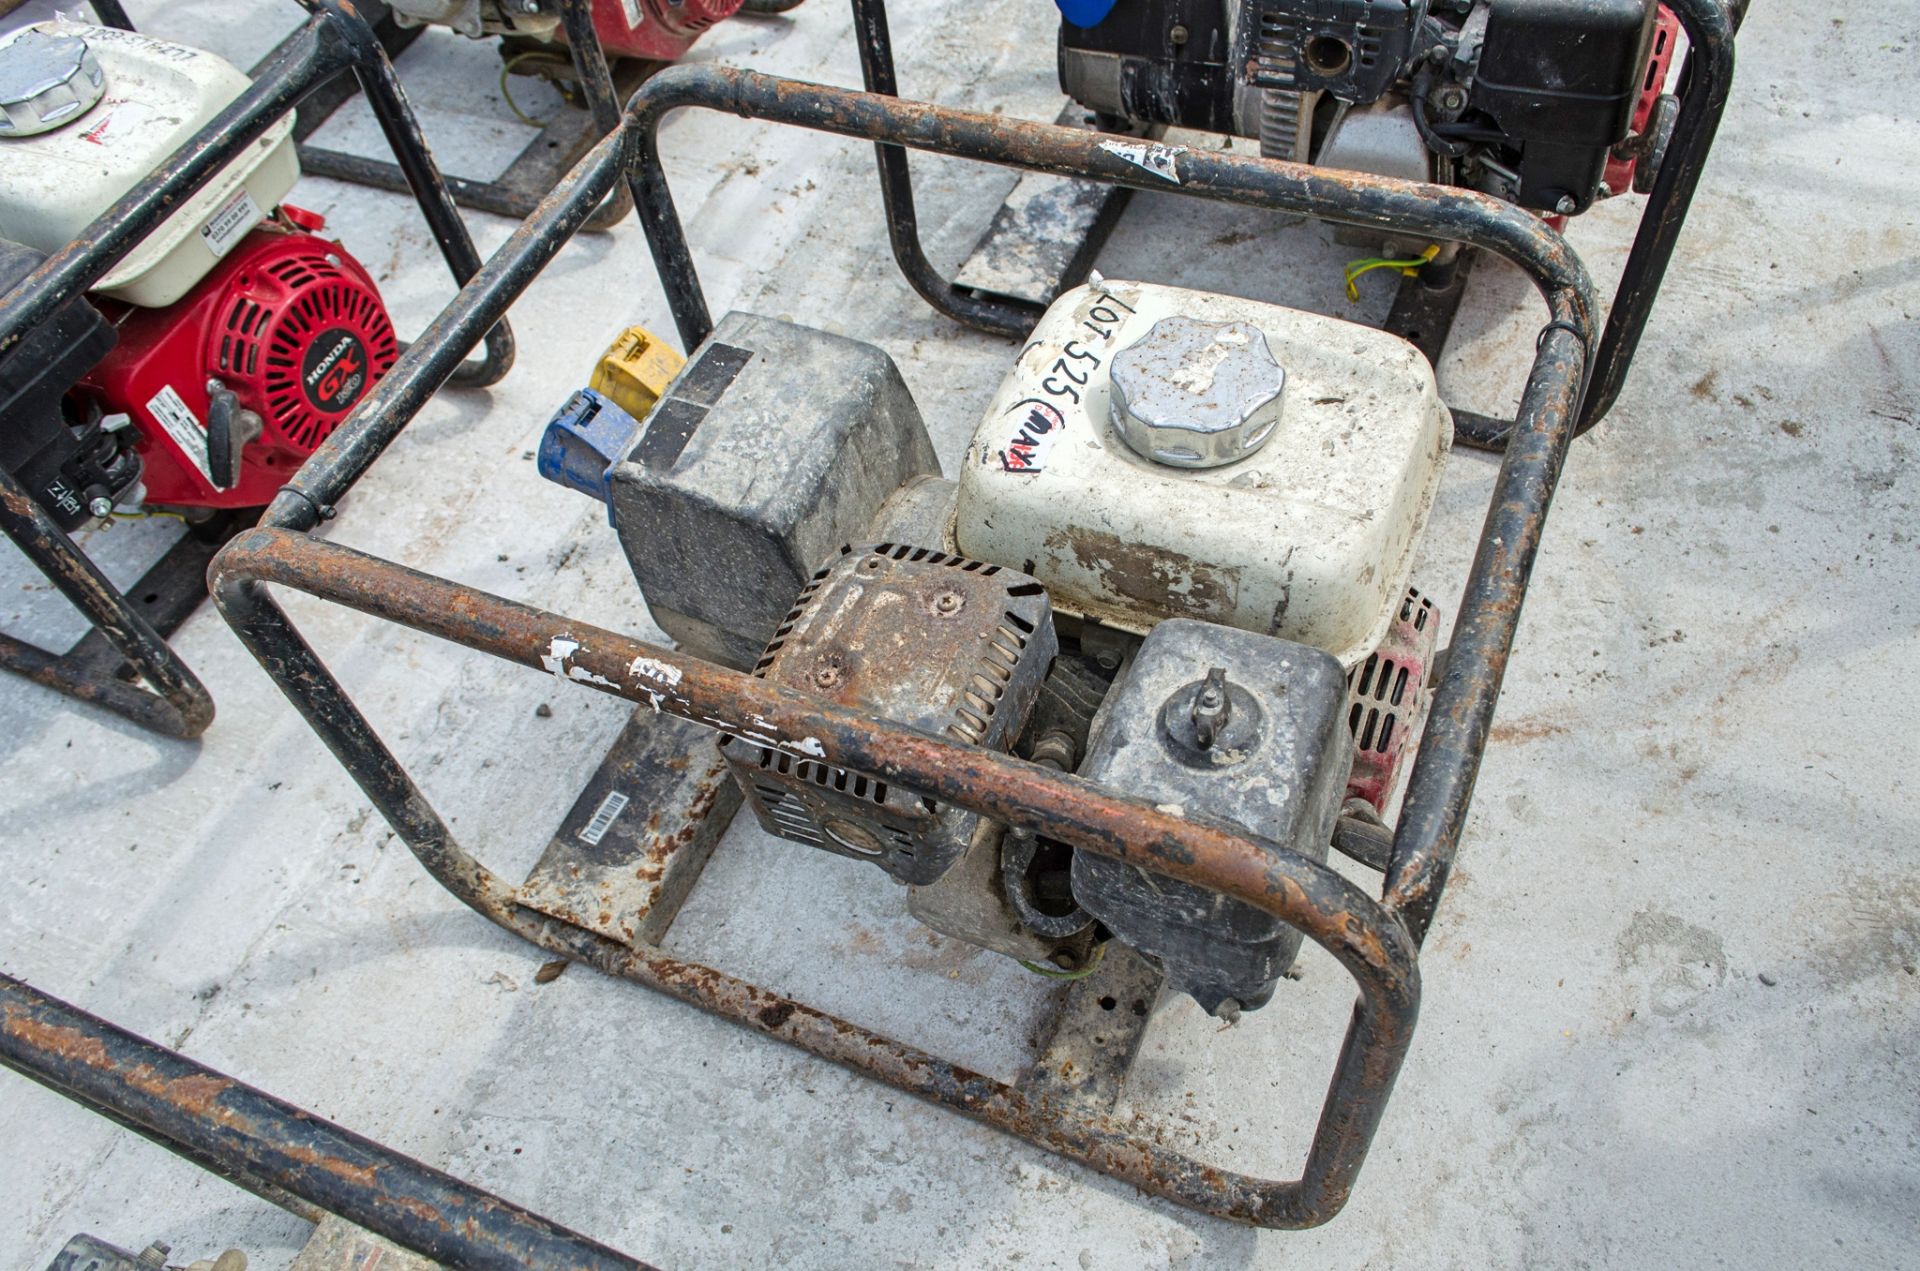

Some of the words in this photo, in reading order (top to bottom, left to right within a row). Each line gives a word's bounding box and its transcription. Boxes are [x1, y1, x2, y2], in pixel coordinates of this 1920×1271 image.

[1084, 294, 1136, 339] LOT
[307, 337, 352, 385] HONDA
[317, 350, 360, 401] GX
[1042, 340, 1101, 404] 525
